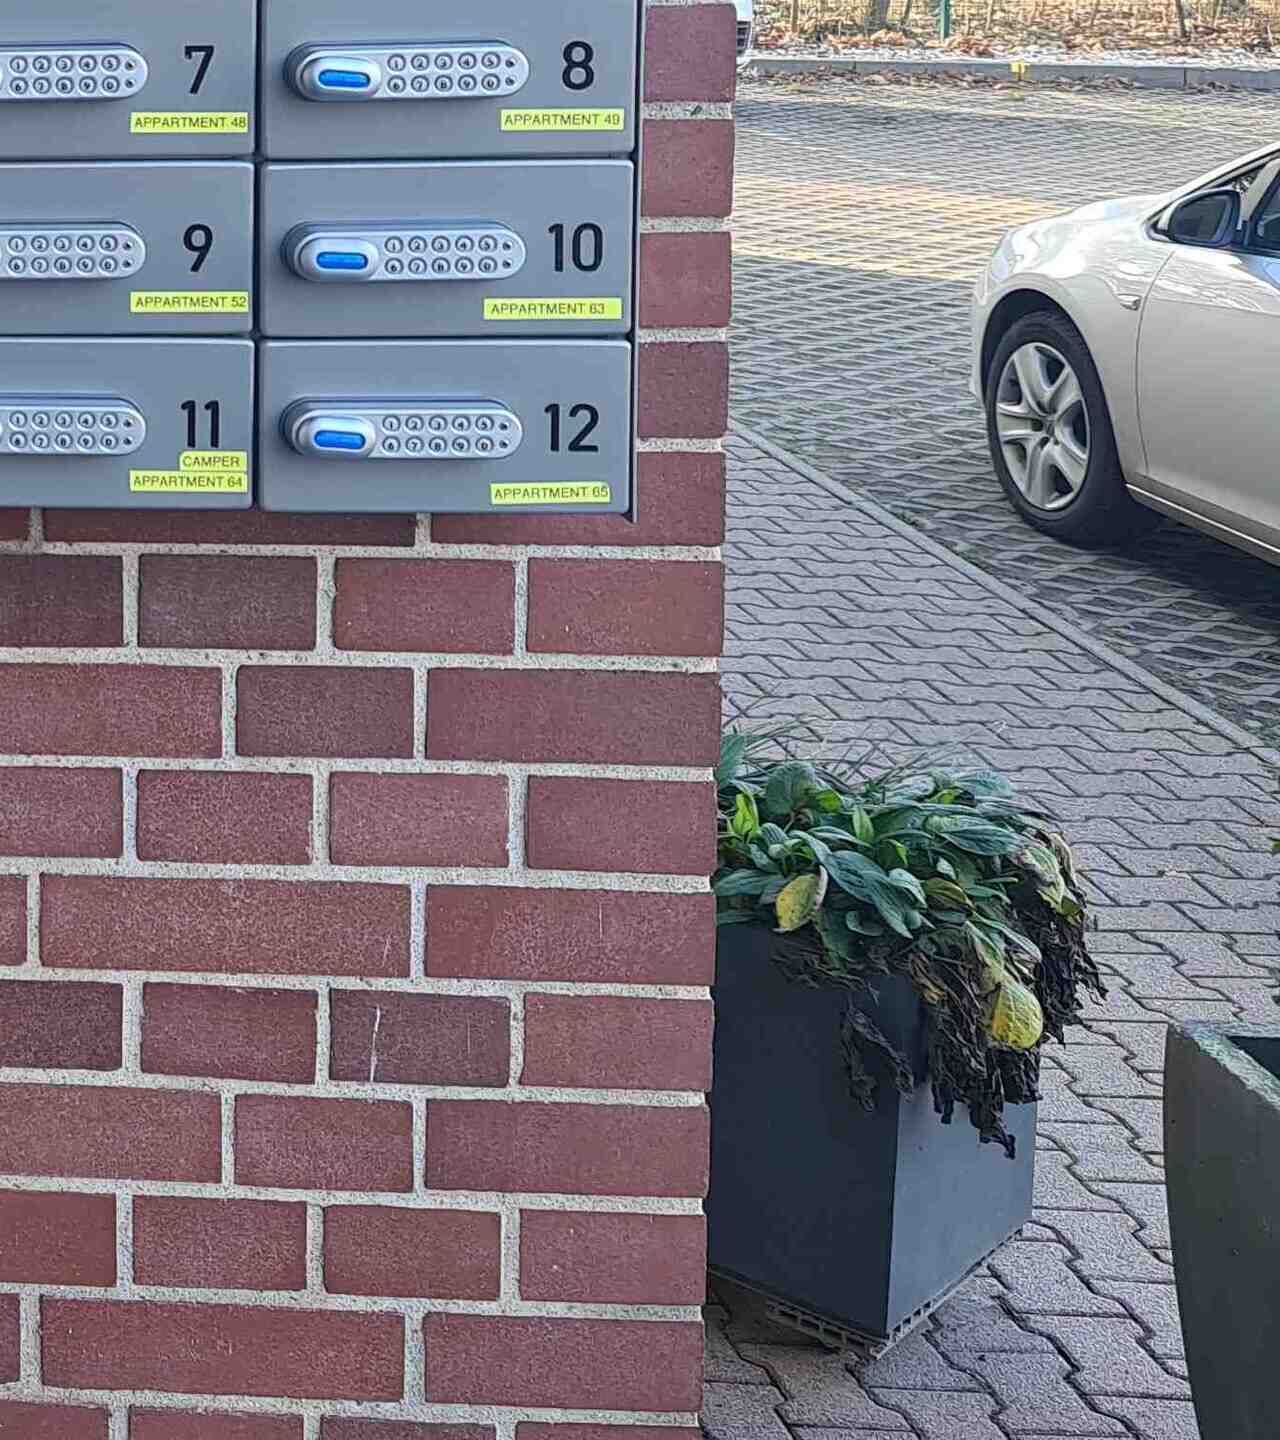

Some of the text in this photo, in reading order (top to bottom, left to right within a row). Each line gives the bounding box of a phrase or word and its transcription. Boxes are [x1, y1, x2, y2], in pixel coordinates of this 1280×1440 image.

[184, 45, 215, 94] 7
[562, 41, 594, 90] 8
[135, 116, 246, 128] APPARTMENT 48
[505, 113, 620, 126] APPARTMENT 49
[184, 224, 212, 272] 9
[549, 224, 604, 272] 10
[136, 296, 247, 308] APPARTMENT 52
[492, 304, 586, 315] APPARTMENT
[181, 400, 221, 448] 11
[544, 404, 599, 452] 12
[183, 455, 240, 467] CAMPER
[134, 475, 242, 488] APPARTMENT 64
[495, 489, 588, 500] APPARTMENT
